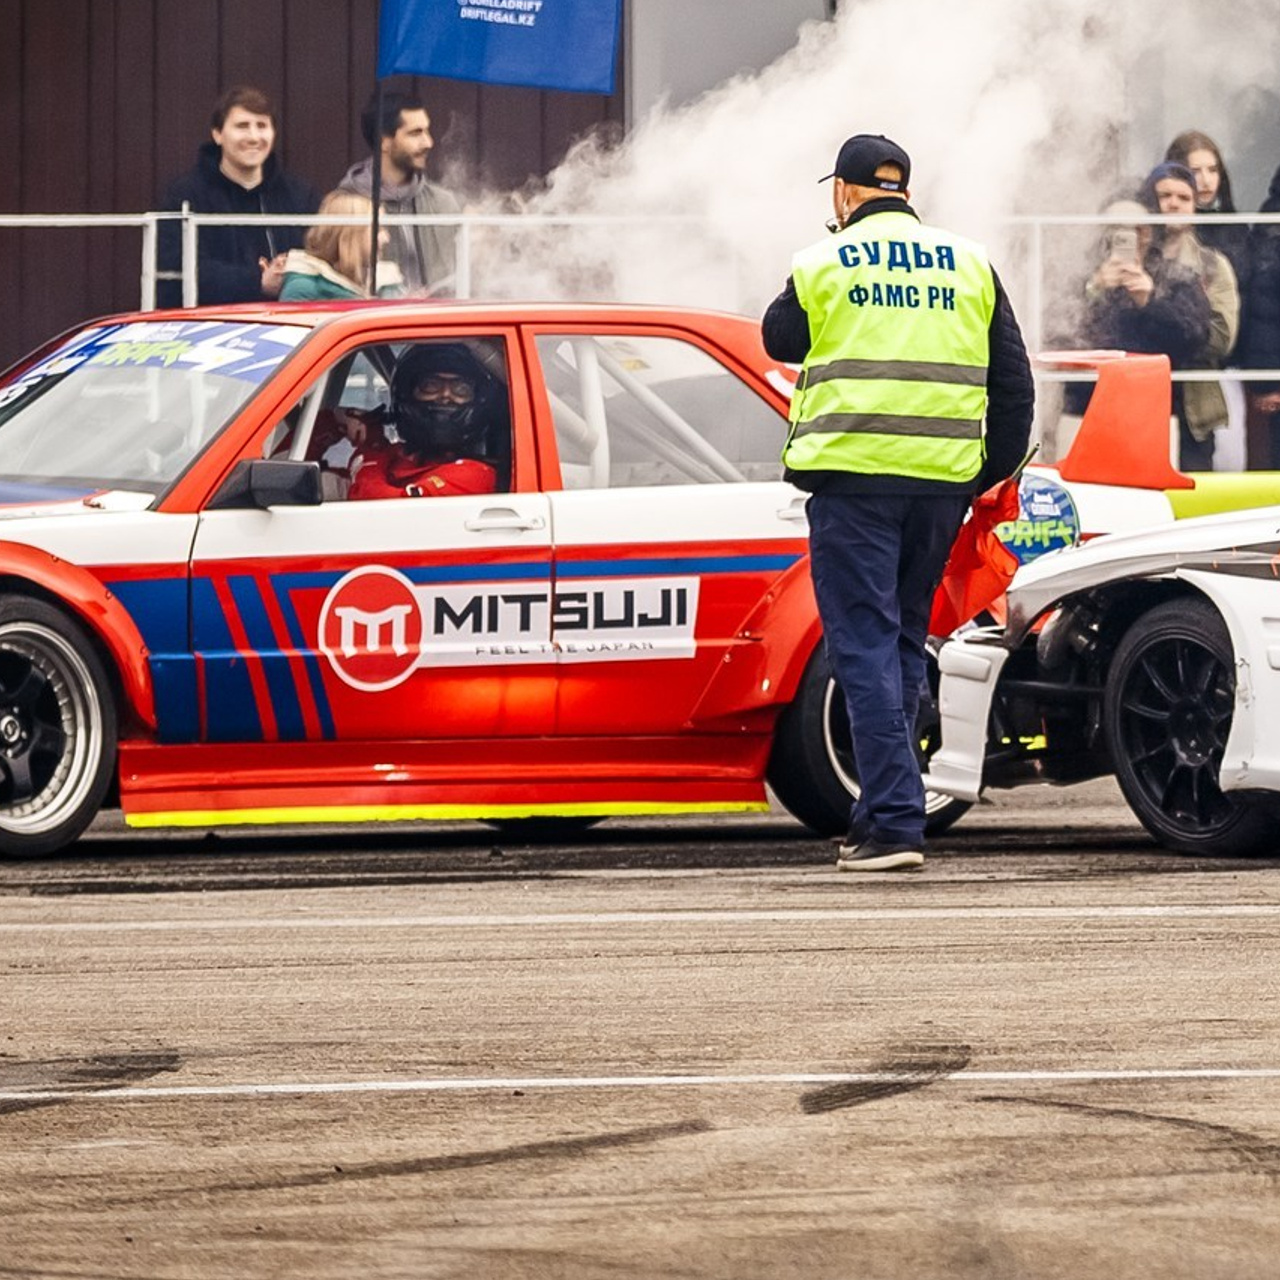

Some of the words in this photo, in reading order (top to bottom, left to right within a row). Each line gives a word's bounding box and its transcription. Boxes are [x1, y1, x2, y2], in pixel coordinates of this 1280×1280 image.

[837, 240, 956, 273] СУДЬЯ
[847, 282, 921, 309] ФАМС
[927, 285, 956, 311] РК
[994, 519, 1074, 549] DRIFT
[433, 587, 688, 636] MITSUJI
[475, 645, 530, 657] FEEL
[586, 641, 655, 654] JAPAN
